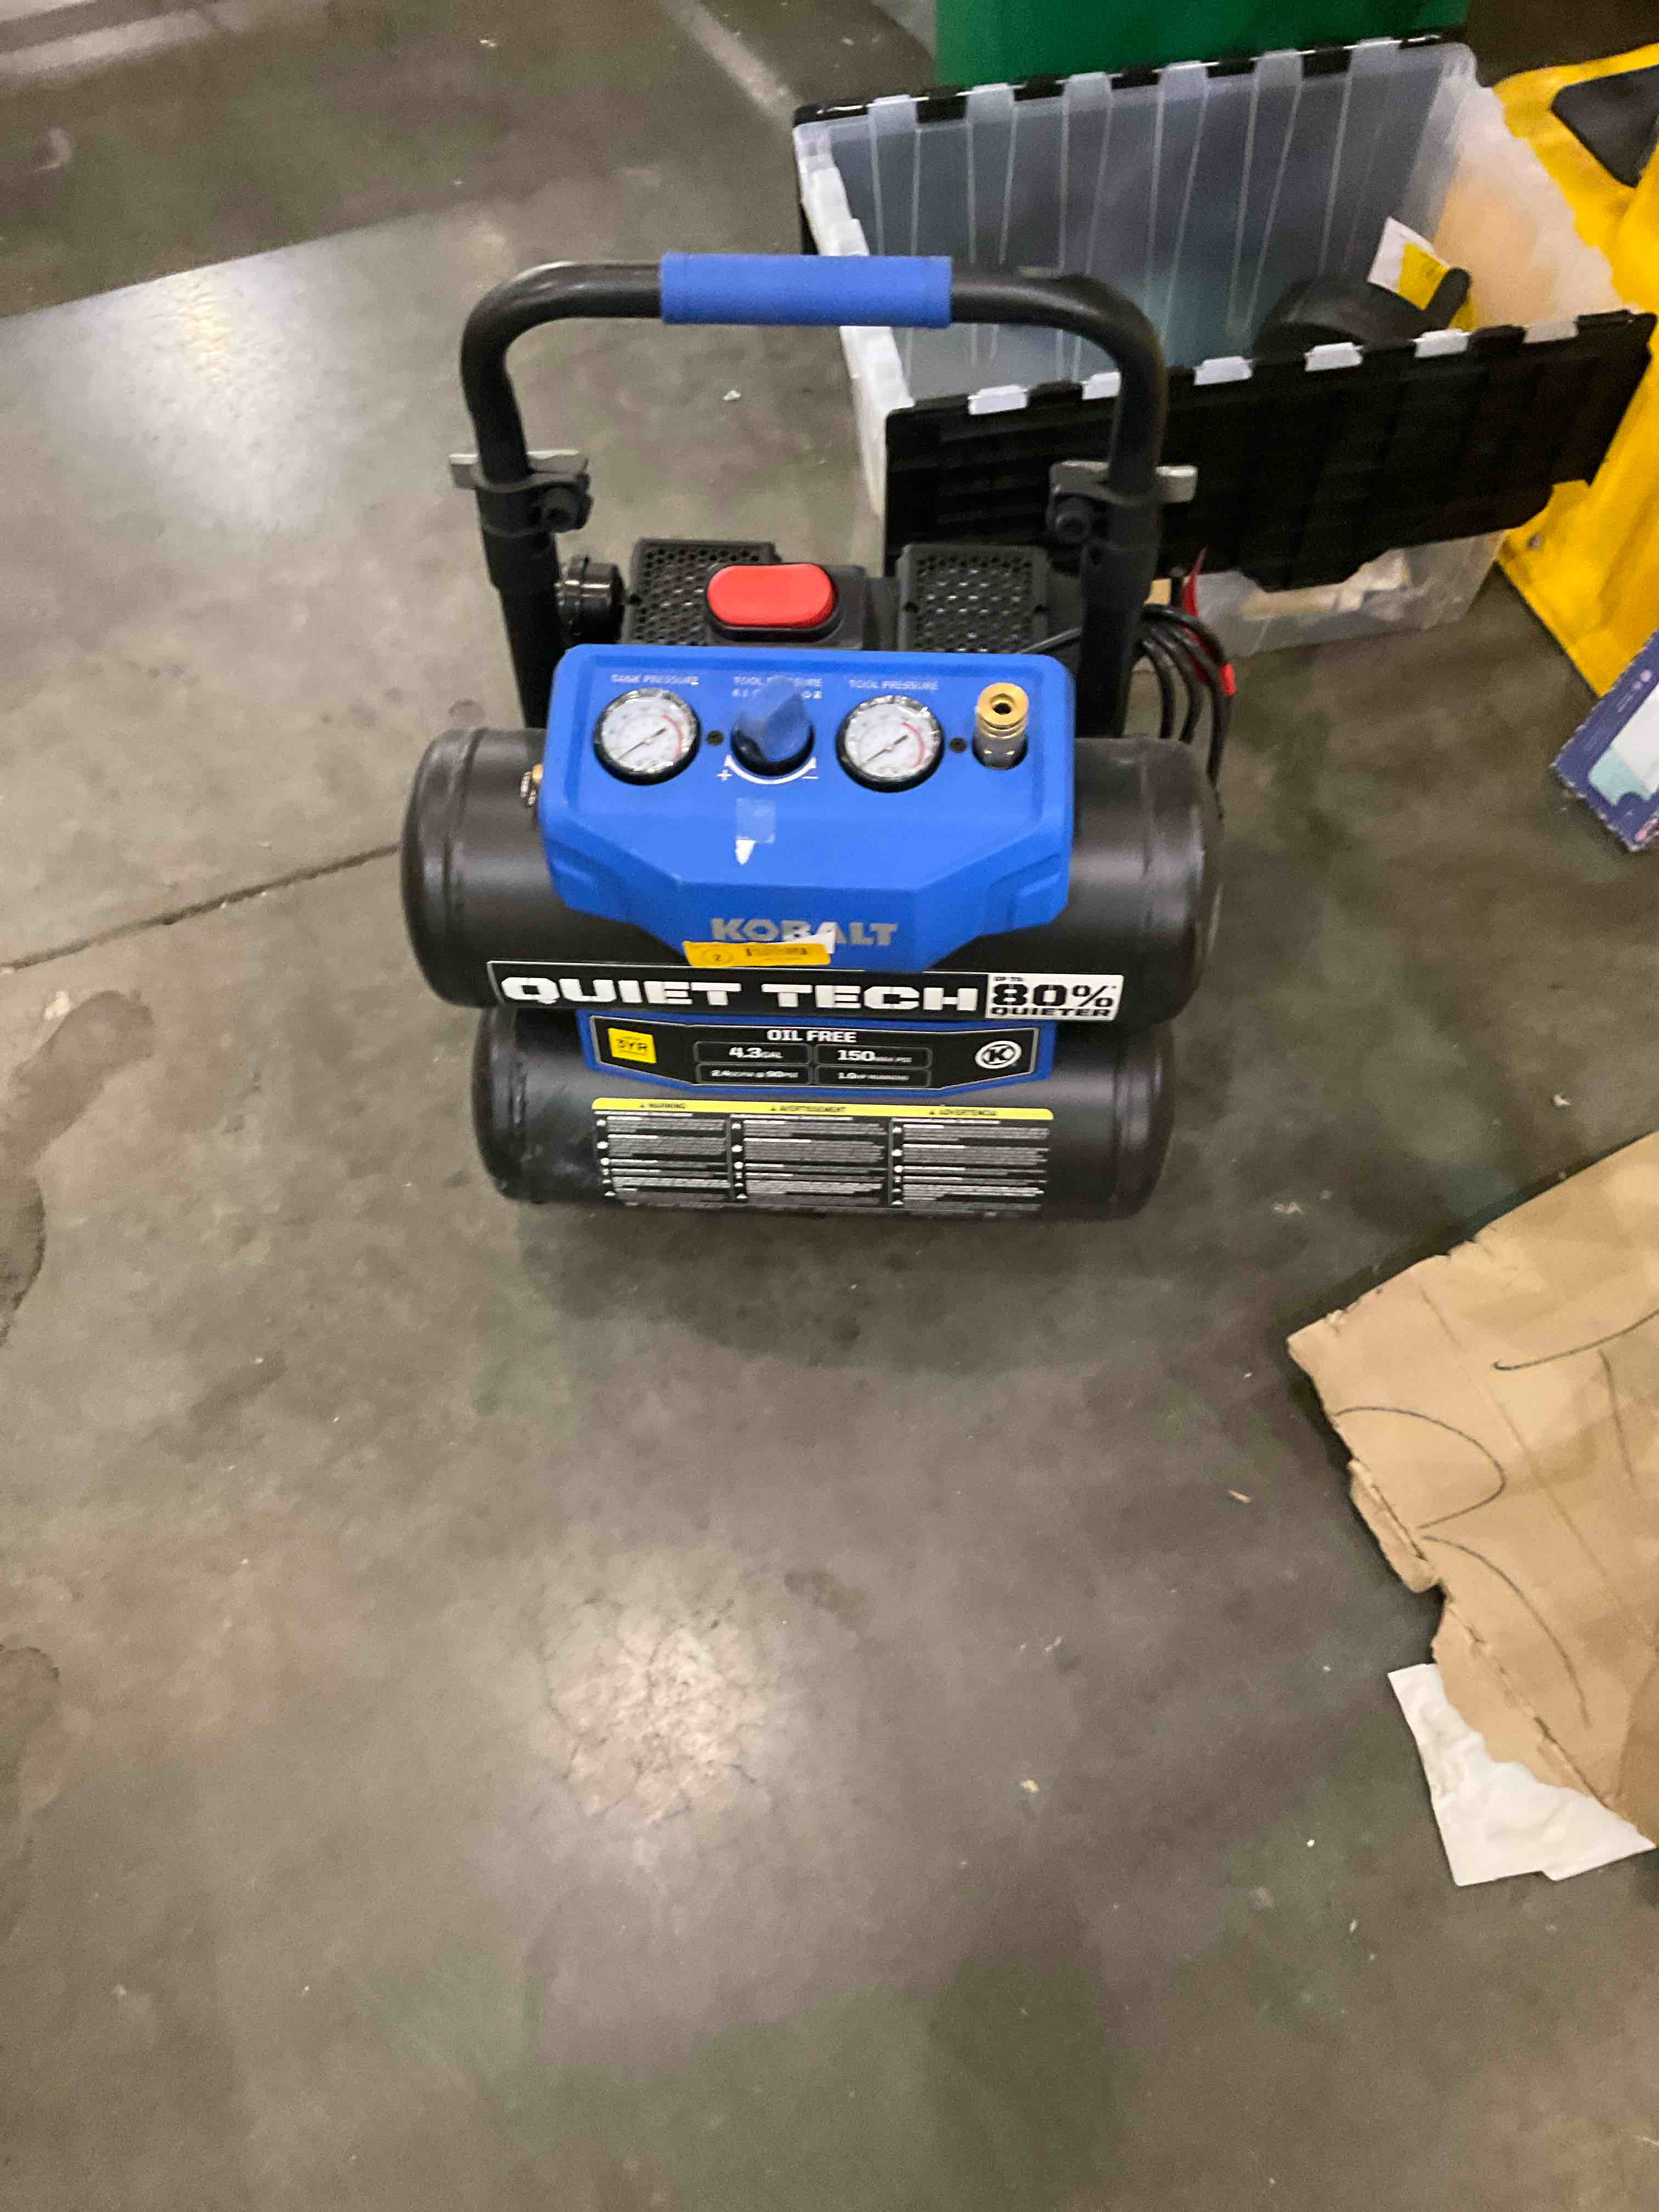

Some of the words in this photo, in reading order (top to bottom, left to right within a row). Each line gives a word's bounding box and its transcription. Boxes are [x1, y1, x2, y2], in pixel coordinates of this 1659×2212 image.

[501, 977, 741, 1007] QUIET
[760, 983, 979, 1011] TECH
[991, 1007, 1111, 1017] QUIETER
[766, 1029, 804, 1041] OIL
[806, 1030, 857, 1043] FREE
